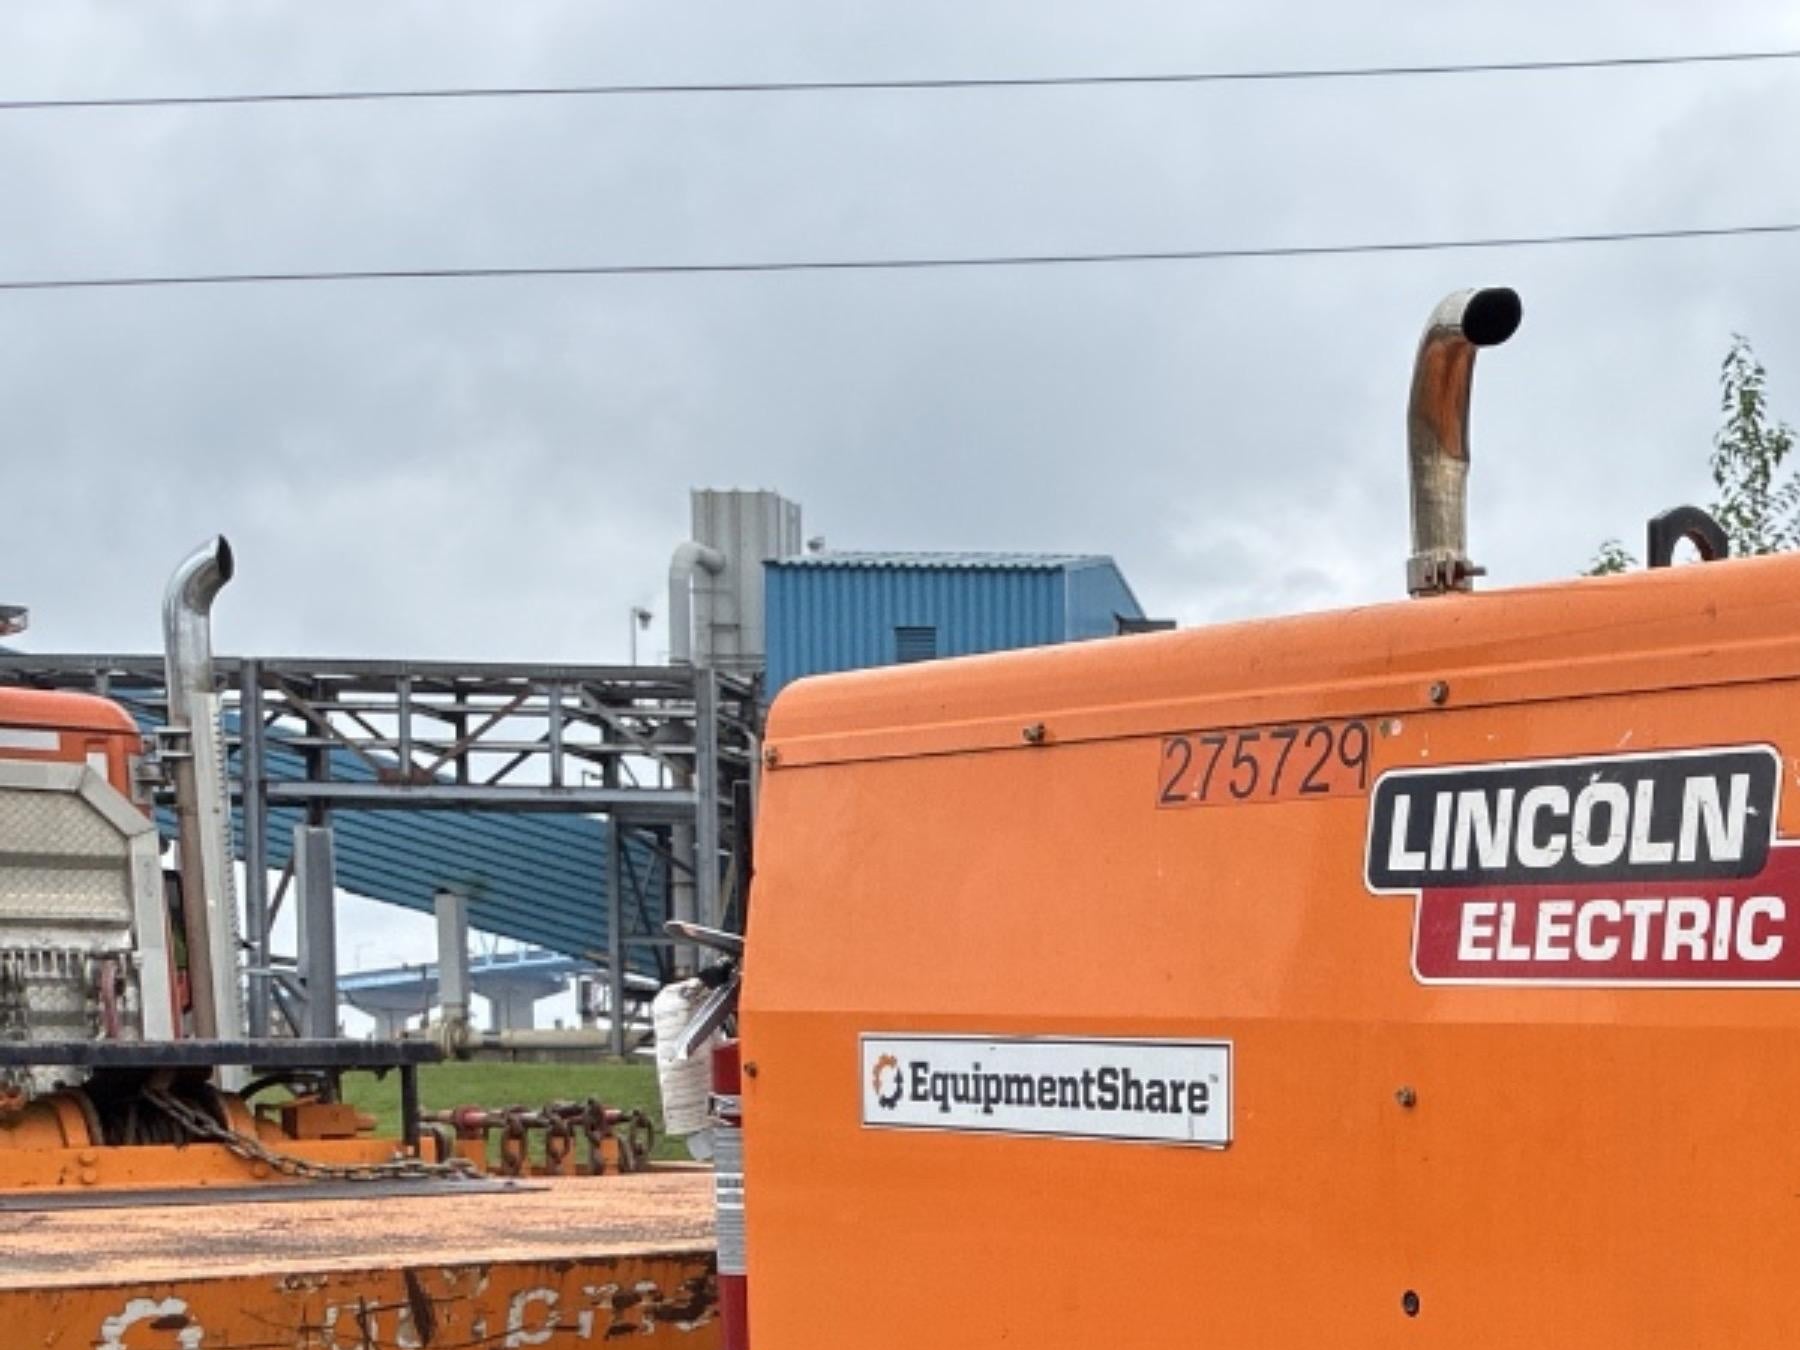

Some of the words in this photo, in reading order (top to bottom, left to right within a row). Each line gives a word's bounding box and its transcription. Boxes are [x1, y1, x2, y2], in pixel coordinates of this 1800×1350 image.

[1160, 720, 1372, 803] 275729
[1386, 774, 1751, 872] LINCOLN
[1456, 896, 1787, 962] ELECTRIC
[909, 1060, 1210, 1116] EquipmentShare
